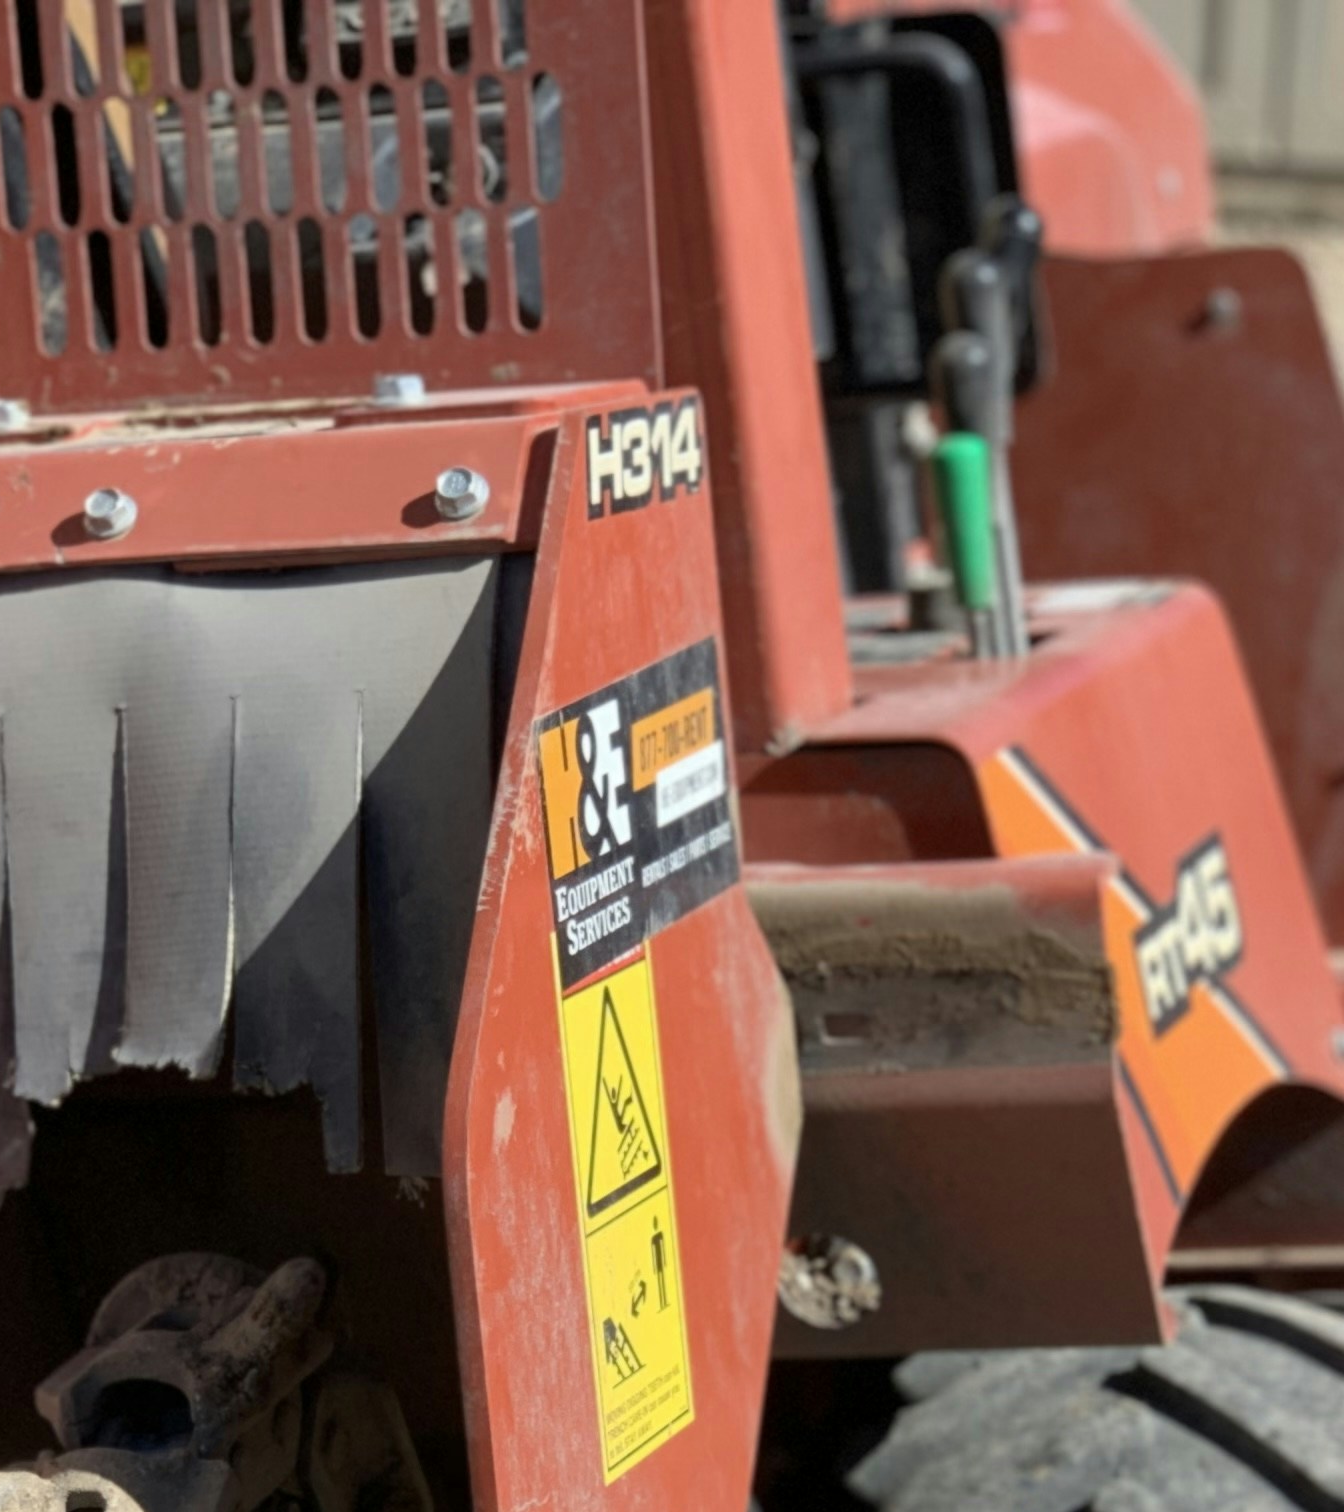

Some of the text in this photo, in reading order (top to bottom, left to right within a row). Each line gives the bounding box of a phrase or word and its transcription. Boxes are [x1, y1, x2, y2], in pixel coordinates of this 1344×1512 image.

[588, 406, 700, 505] H314
[539, 699, 633, 879] H&E
[555, 857, 634, 923] EQUIPMENT
[566, 896, 632, 956] SERVICES
